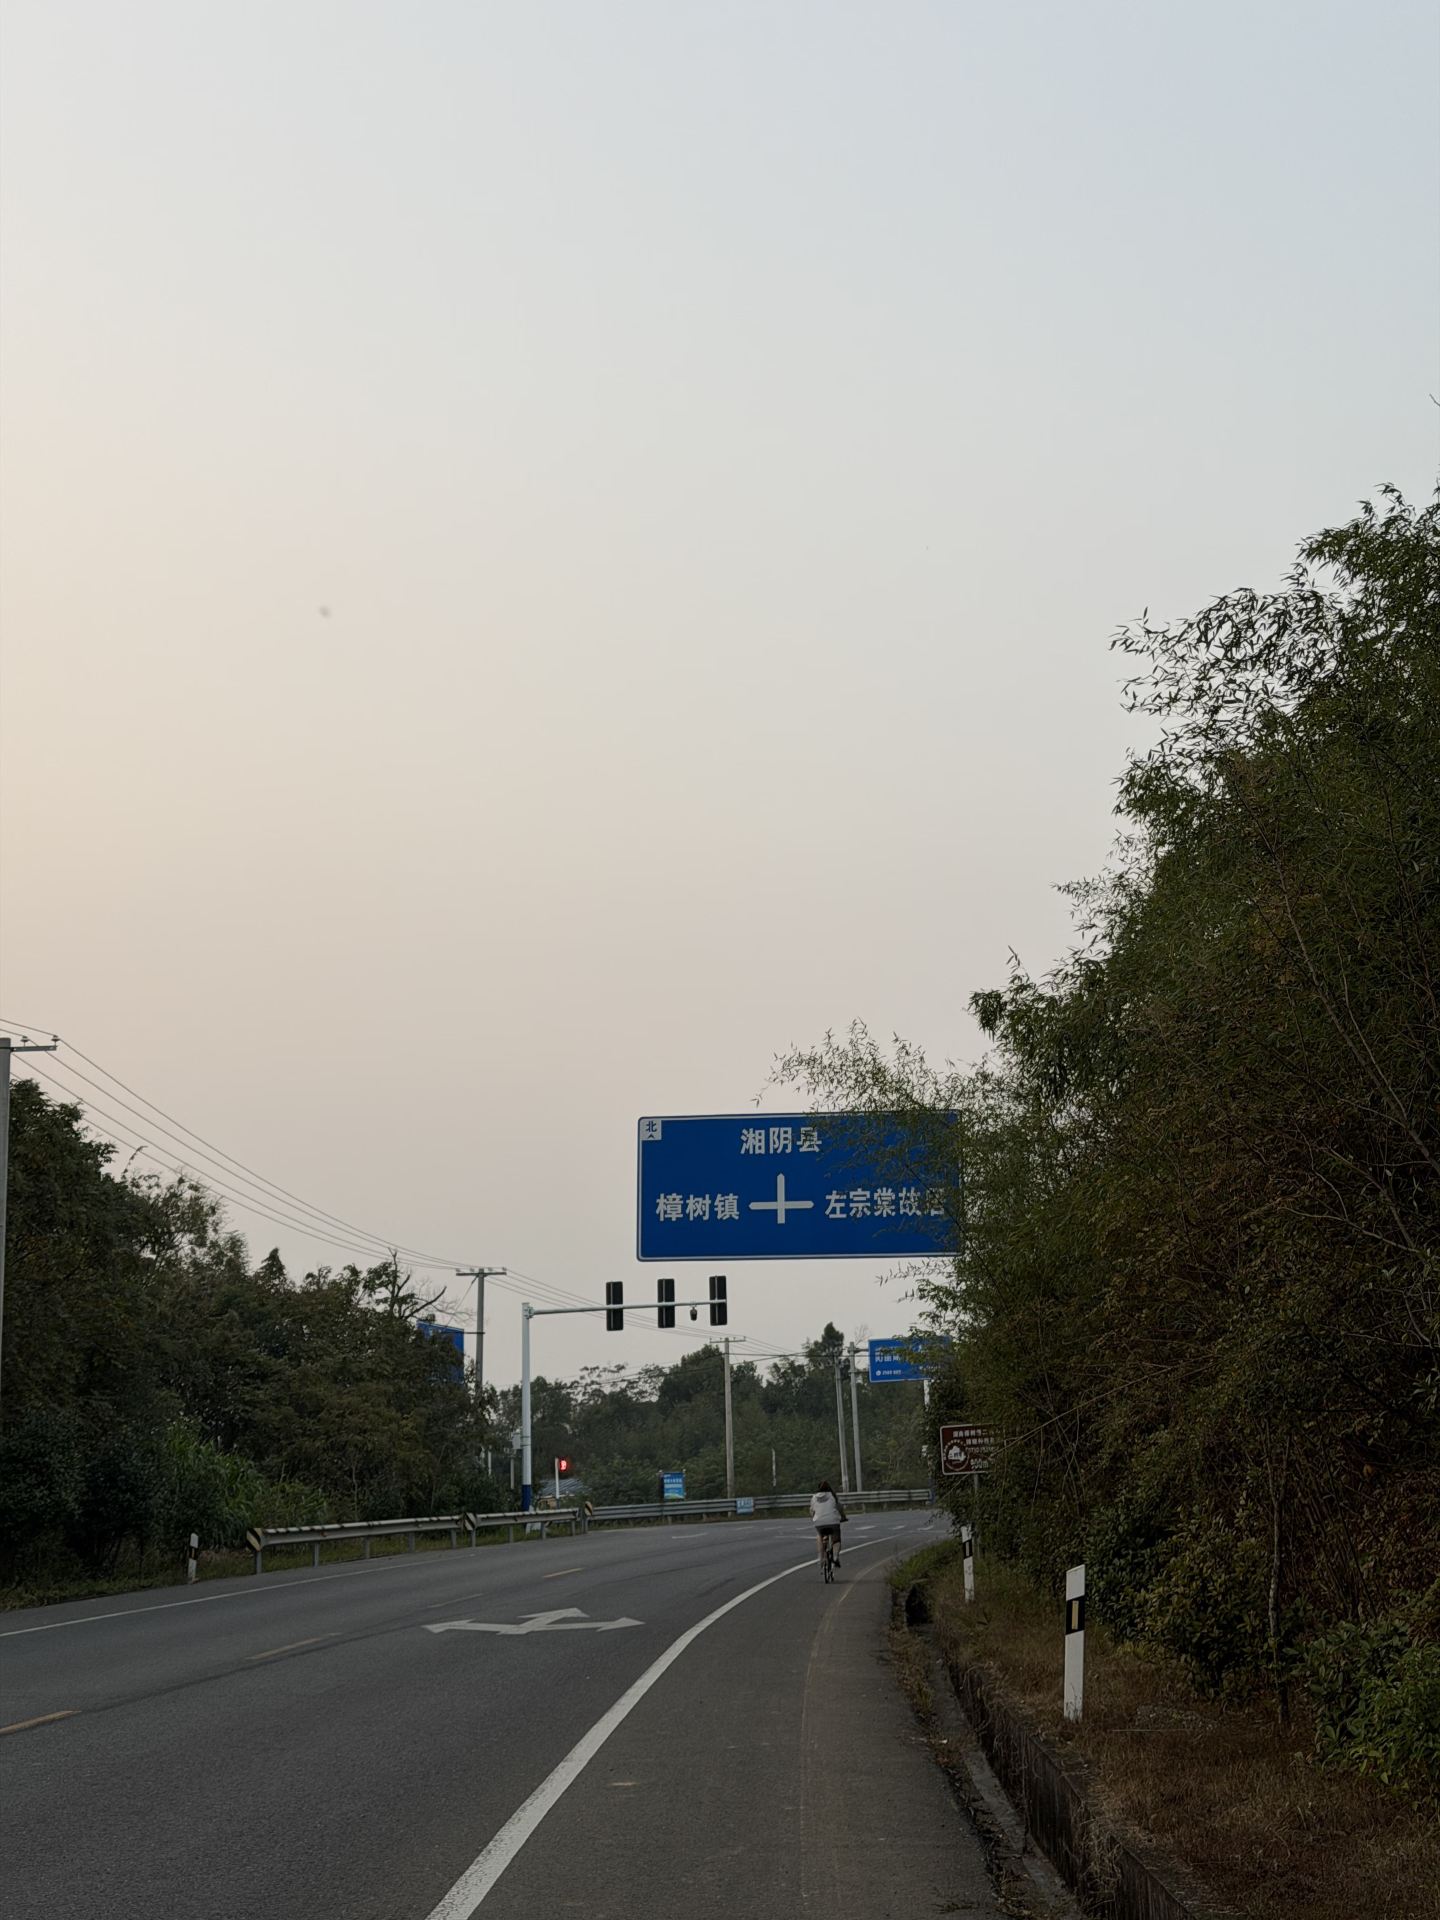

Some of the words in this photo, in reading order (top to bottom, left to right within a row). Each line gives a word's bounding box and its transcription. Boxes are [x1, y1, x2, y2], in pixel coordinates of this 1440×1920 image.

[645, 1120, 657, 1133] 北
[740, 1127, 822, 1155] 湘阴县
[655, 1193, 740, 1222] 樟树镇
